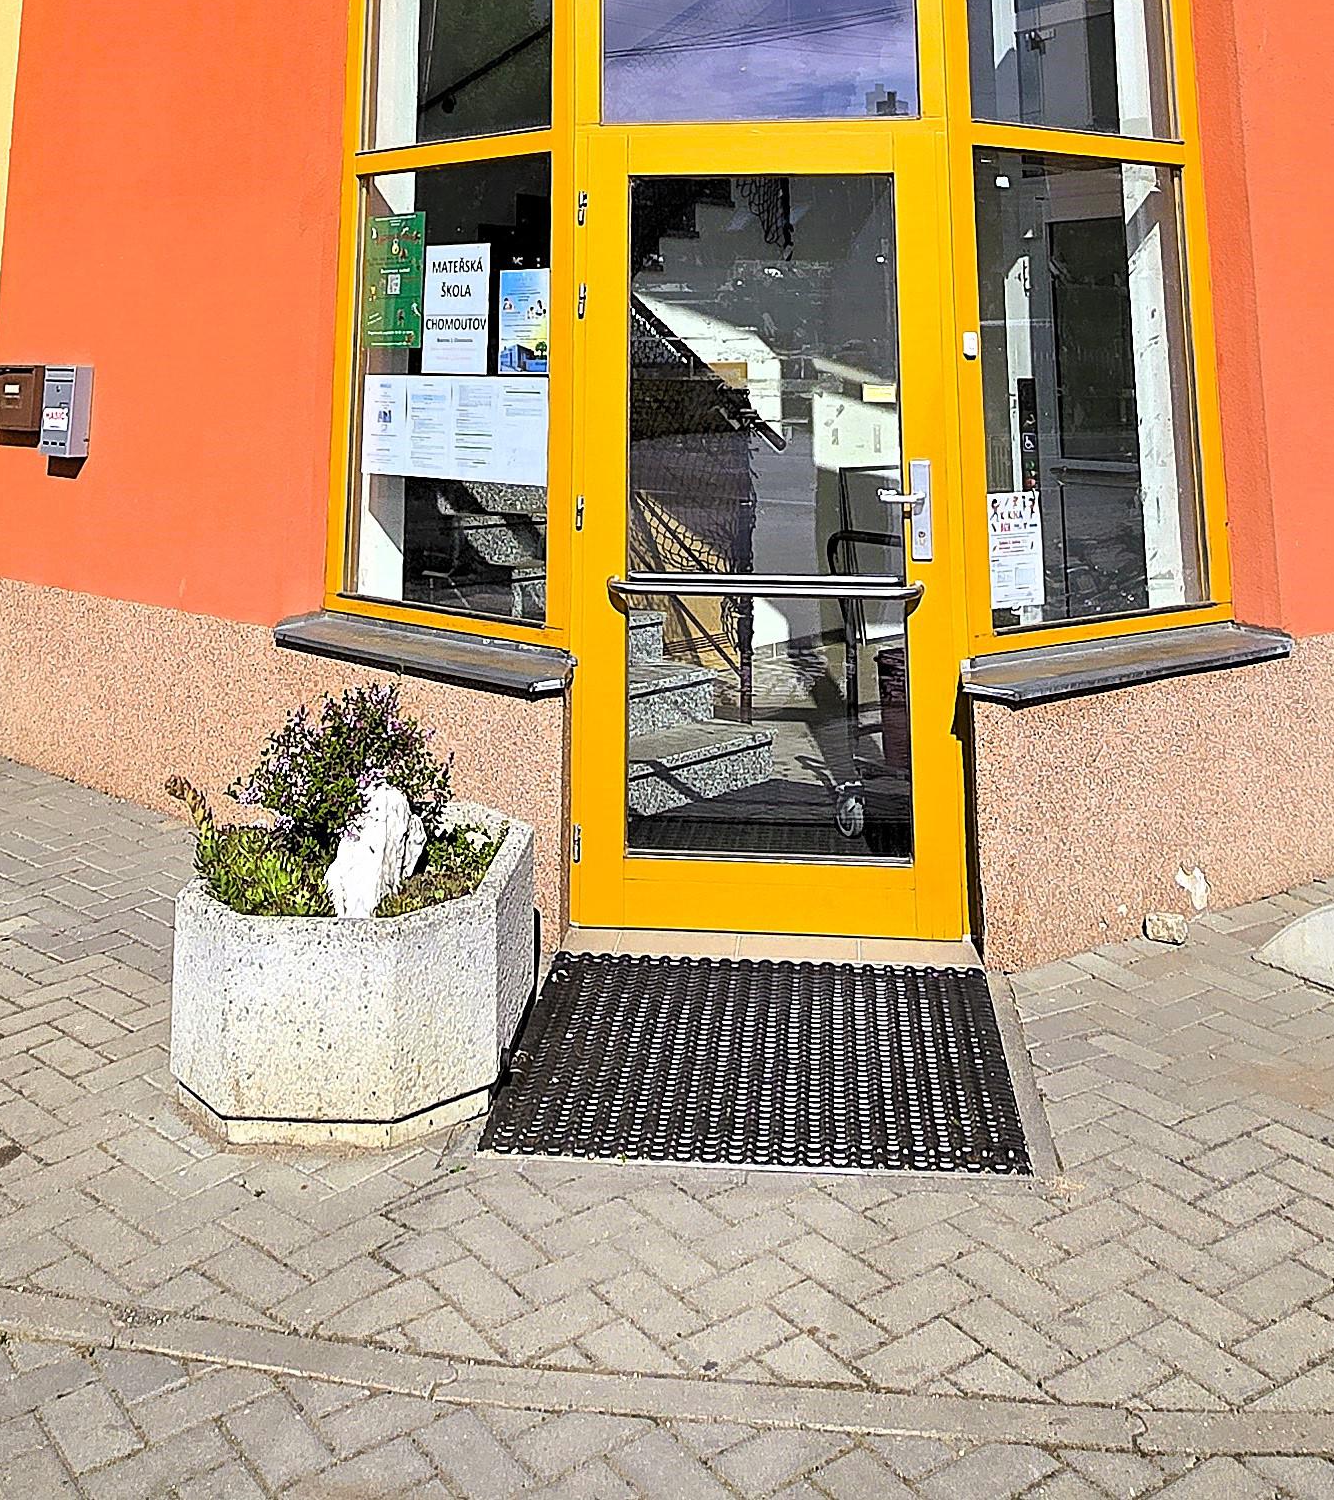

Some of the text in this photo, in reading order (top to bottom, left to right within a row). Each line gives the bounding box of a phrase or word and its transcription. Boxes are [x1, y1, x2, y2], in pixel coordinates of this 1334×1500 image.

[432, 257, 484, 274] MATEŘSKÁ
[440, 282, 472, 297] ŠKOLA
[425, 318, 487, 330] CHOMOUTOV
